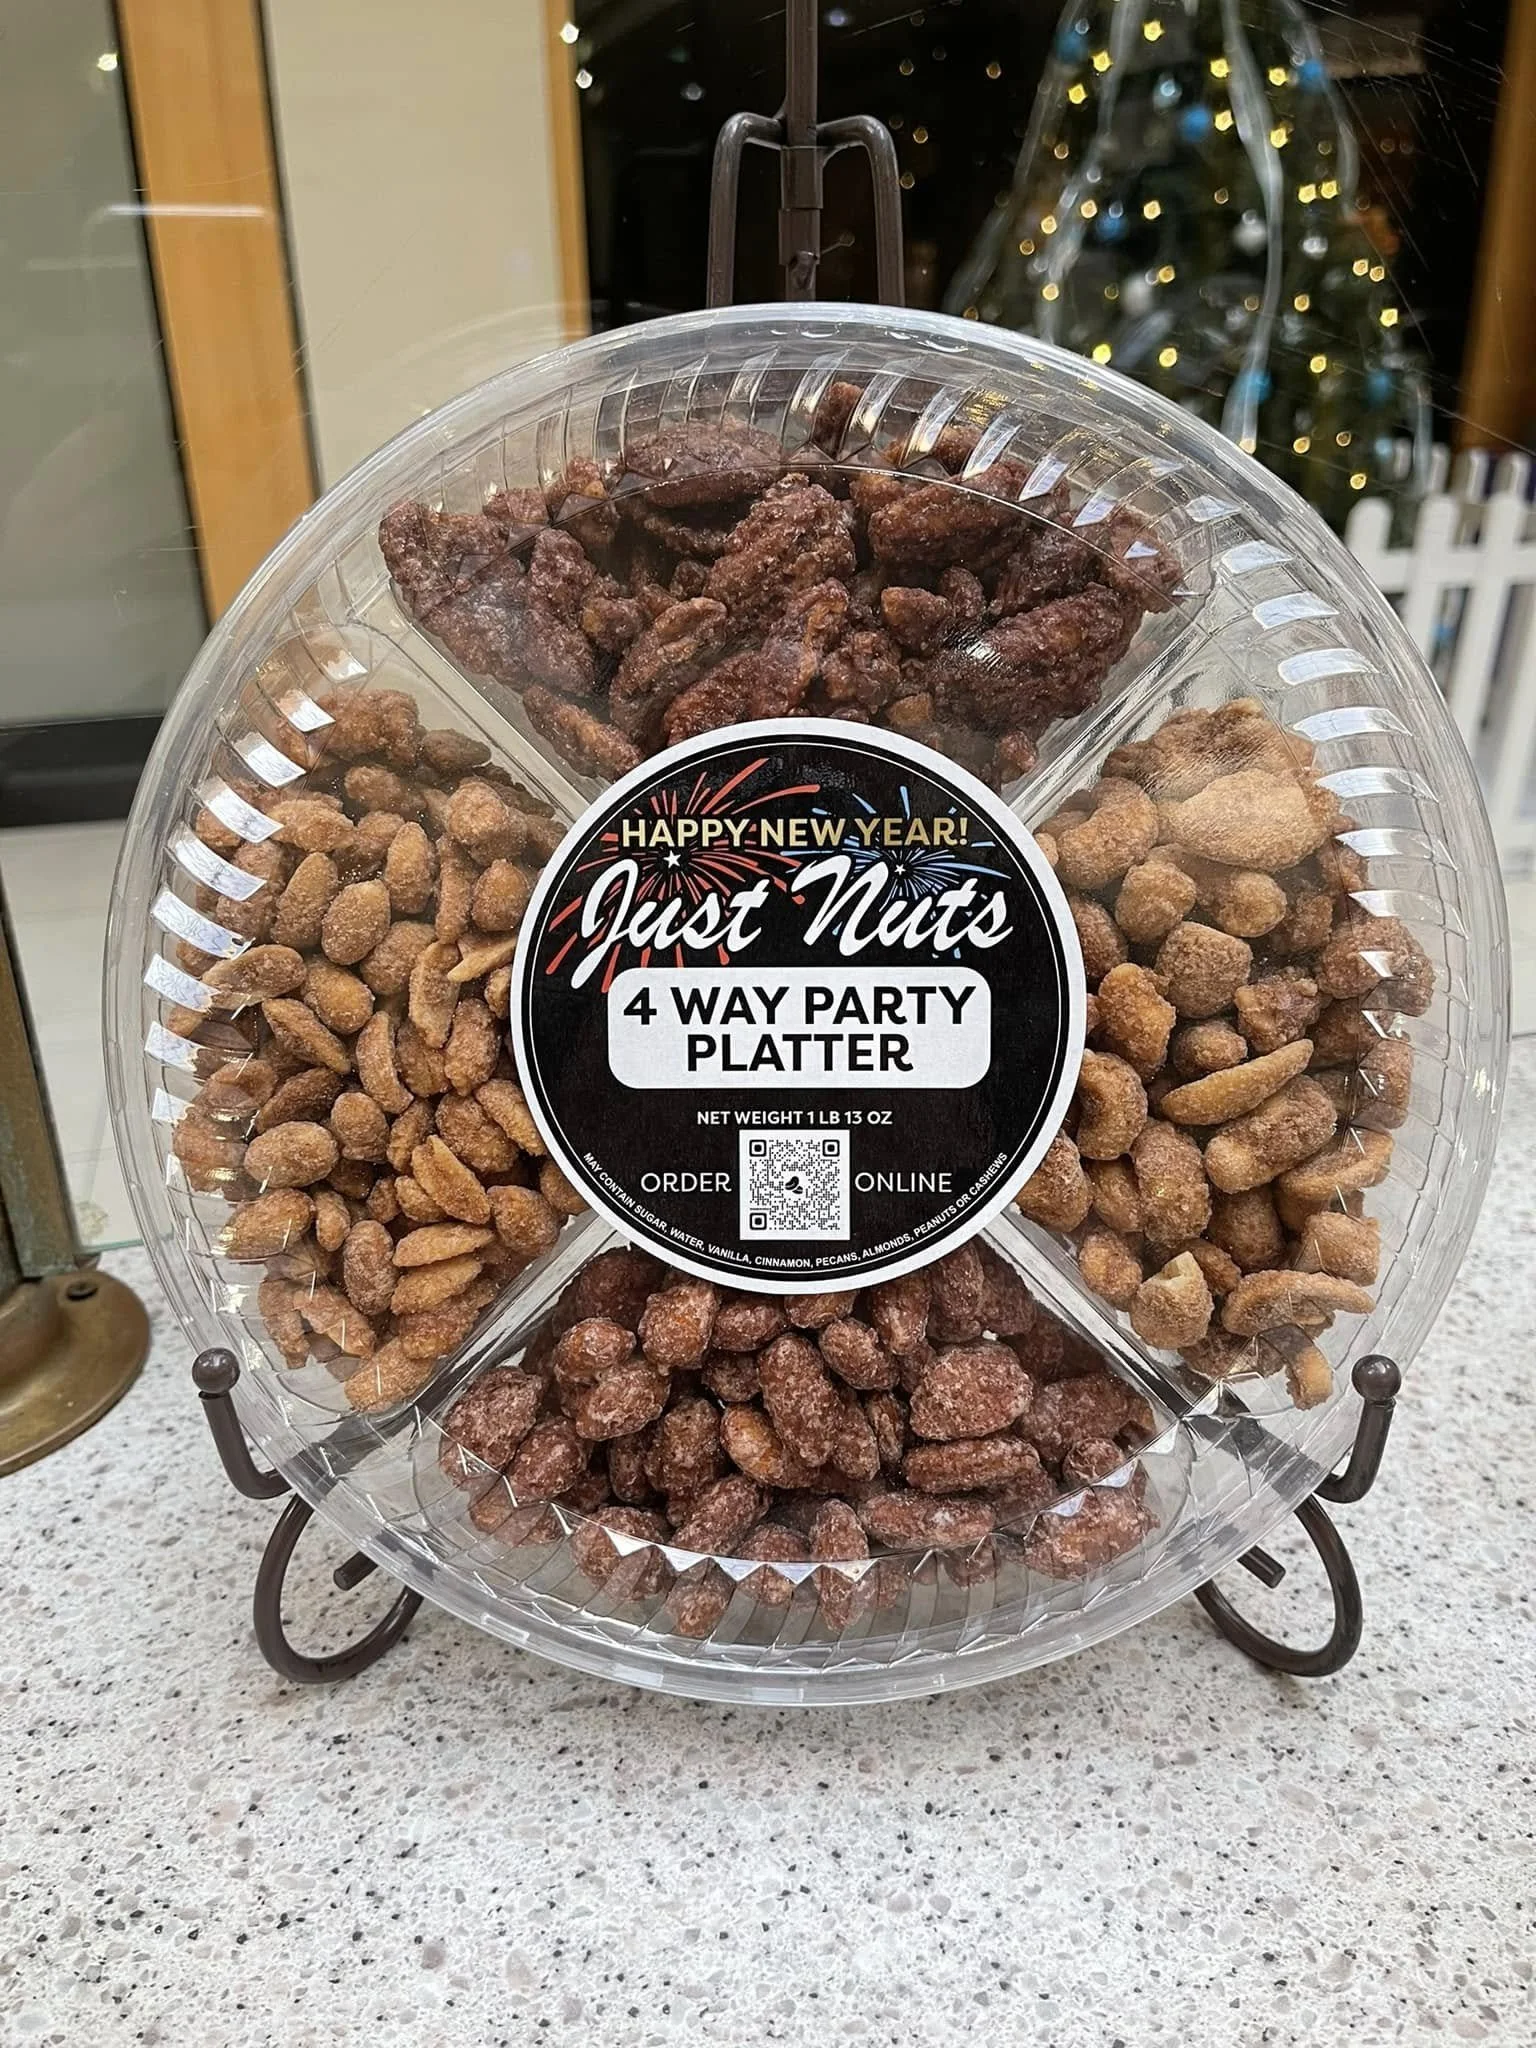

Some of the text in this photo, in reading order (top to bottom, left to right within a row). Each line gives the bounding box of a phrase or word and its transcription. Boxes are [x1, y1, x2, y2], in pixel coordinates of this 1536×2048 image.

[622, 817, 968, 848] HAPPY NEW YEAR!
[571, 854, 1014, 989] Just Nuts
[623, 986, 977, 1026] 4 WAY PARTY
[687, 1033, 914, 1072] PLATTER
[697, 1110, 893, 1125] NET WEIGHT 1 LB 13 OZ
[640, 1172, 953, 1193] ORDER ONLINE
[583, 1152, 1008, 1268] MAY CONTAIN SUGAR, WATER, VANILLA, CINNAMON, PECANS, ALMONDS, PEANUTS OR CASHEWS
